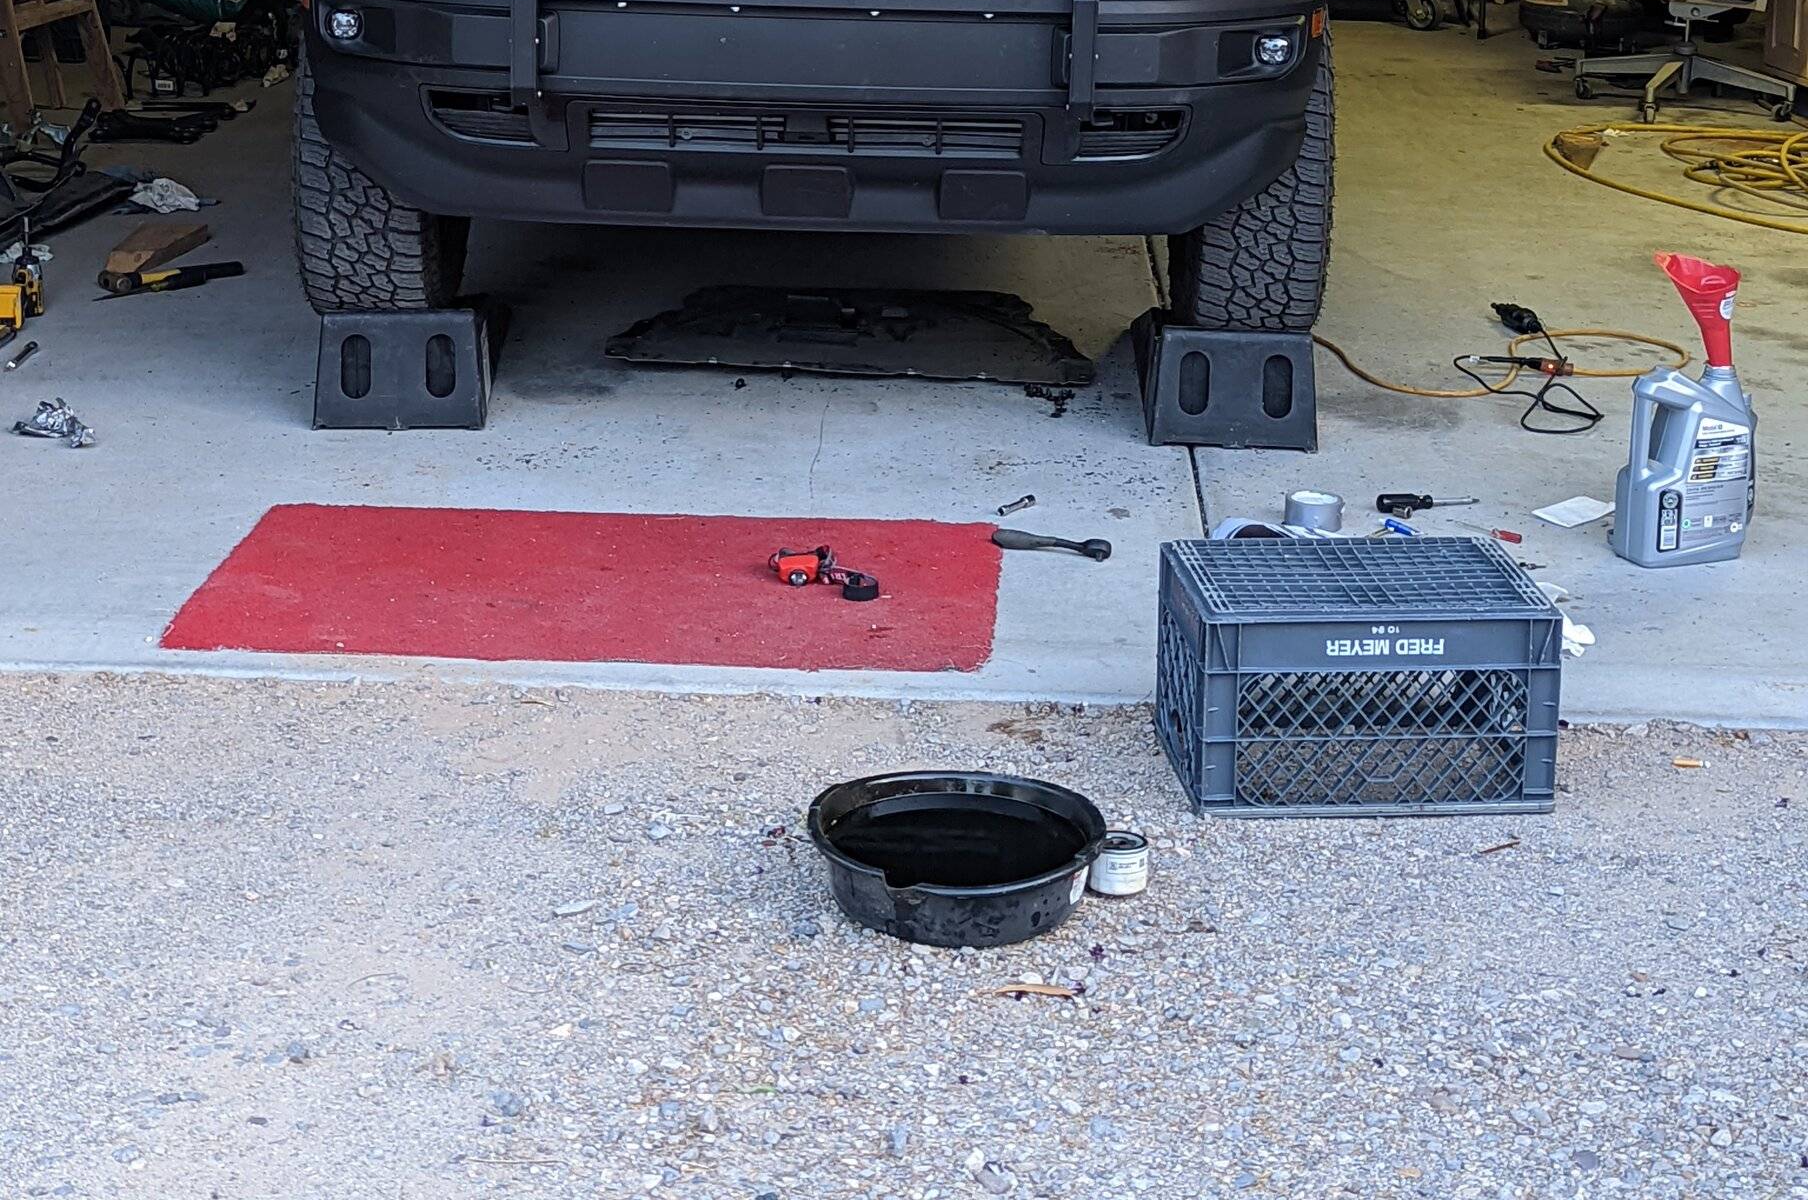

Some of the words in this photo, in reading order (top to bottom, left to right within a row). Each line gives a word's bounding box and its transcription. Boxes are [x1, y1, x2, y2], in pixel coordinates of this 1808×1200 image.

[1387, 625, 1400, 634] 10
[1326, 639, 1390, 656] MEYER
[1395, 638, 1445, 655] FRED
